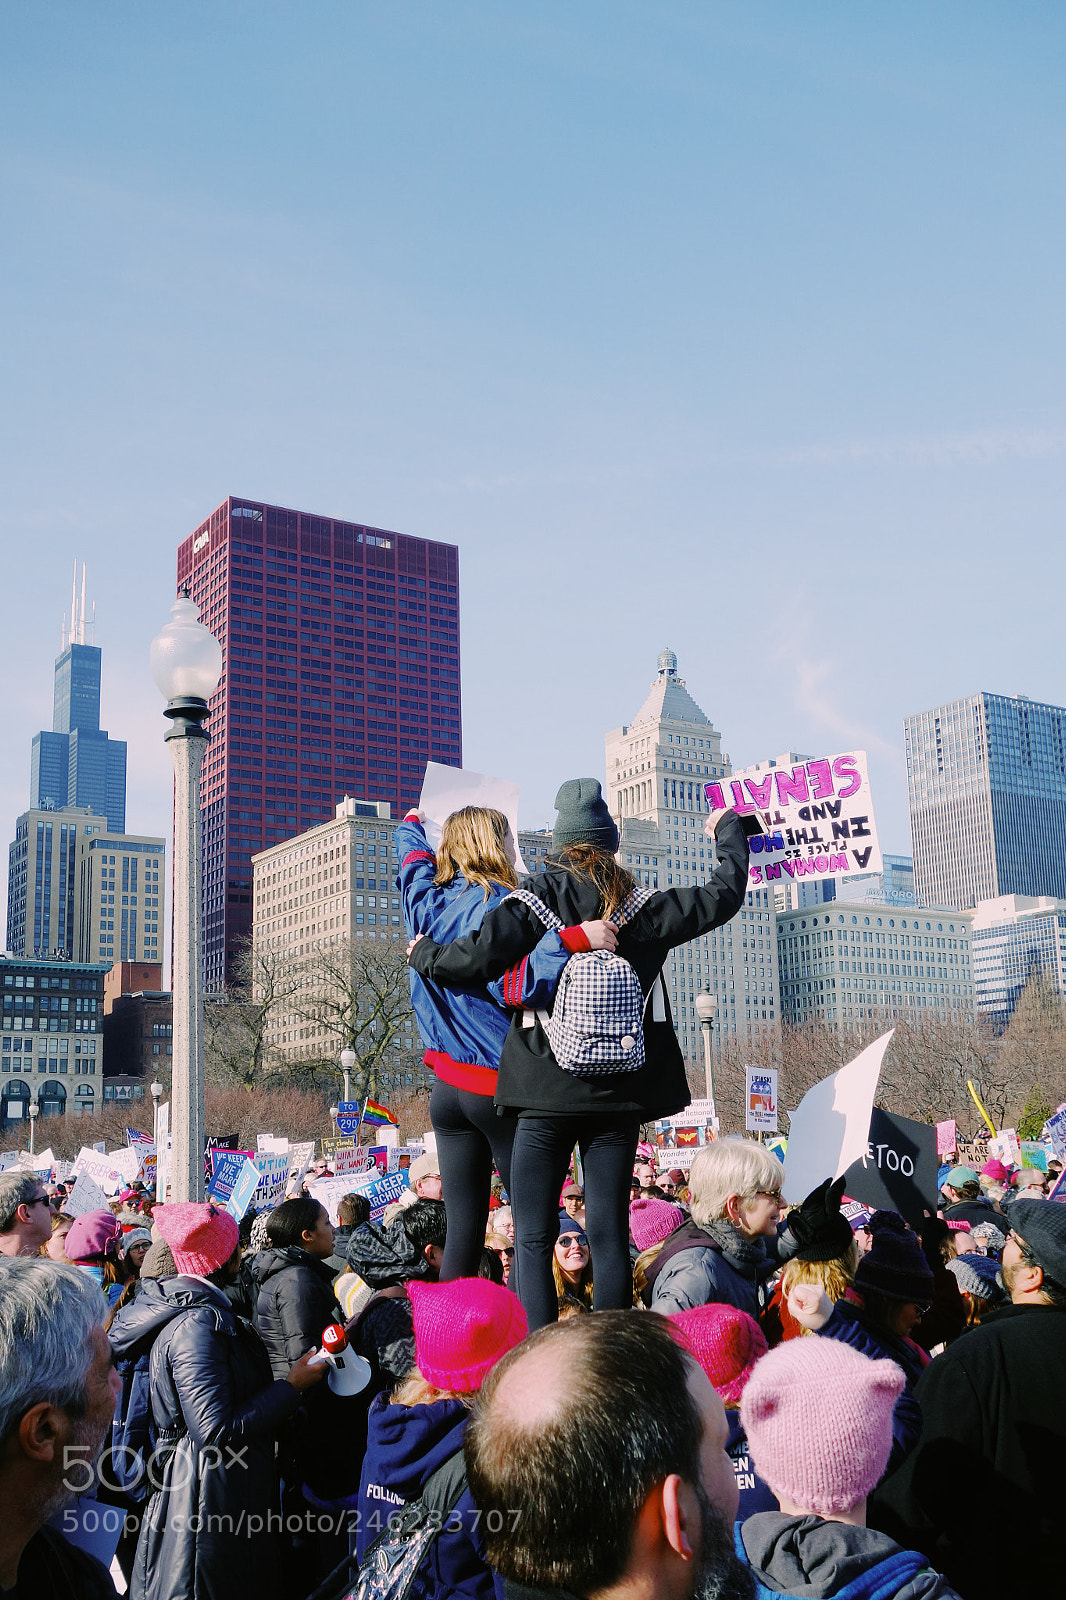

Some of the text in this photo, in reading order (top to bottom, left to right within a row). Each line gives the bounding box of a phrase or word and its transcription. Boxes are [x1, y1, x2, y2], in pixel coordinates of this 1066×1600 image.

[193, 529, 210, 554] CNA
[704, 755, 862, 814] SENATE
[798, 800, 842, 821] AND
[786, 826, 824, 846] THE
[832, 816, 871, 840] IN
[785, 840, 847, 860] PLACE IS
[852, 846, 873, 868] A
[340, 1119, 357, 1129] 290
[216, 1152, 226, 1161] WE
[228, 1153, 244, 1163] KEEP
[336, 1149, 355, 1160] WHAT
[660, 1150, 687, 1158] Wonder
[862, 1142, 914, 1177] ETOO
[959, 1146, 989, 1155] WE ARE
[968, 1154, 988, 1162] NOT
[222, 1161, 237, 1175] WE
[337, 1161, 345, 1170] WE
[375, 1173, 404, 1195] KEEP
[369, 1184, 407, 1208] ARCHING
